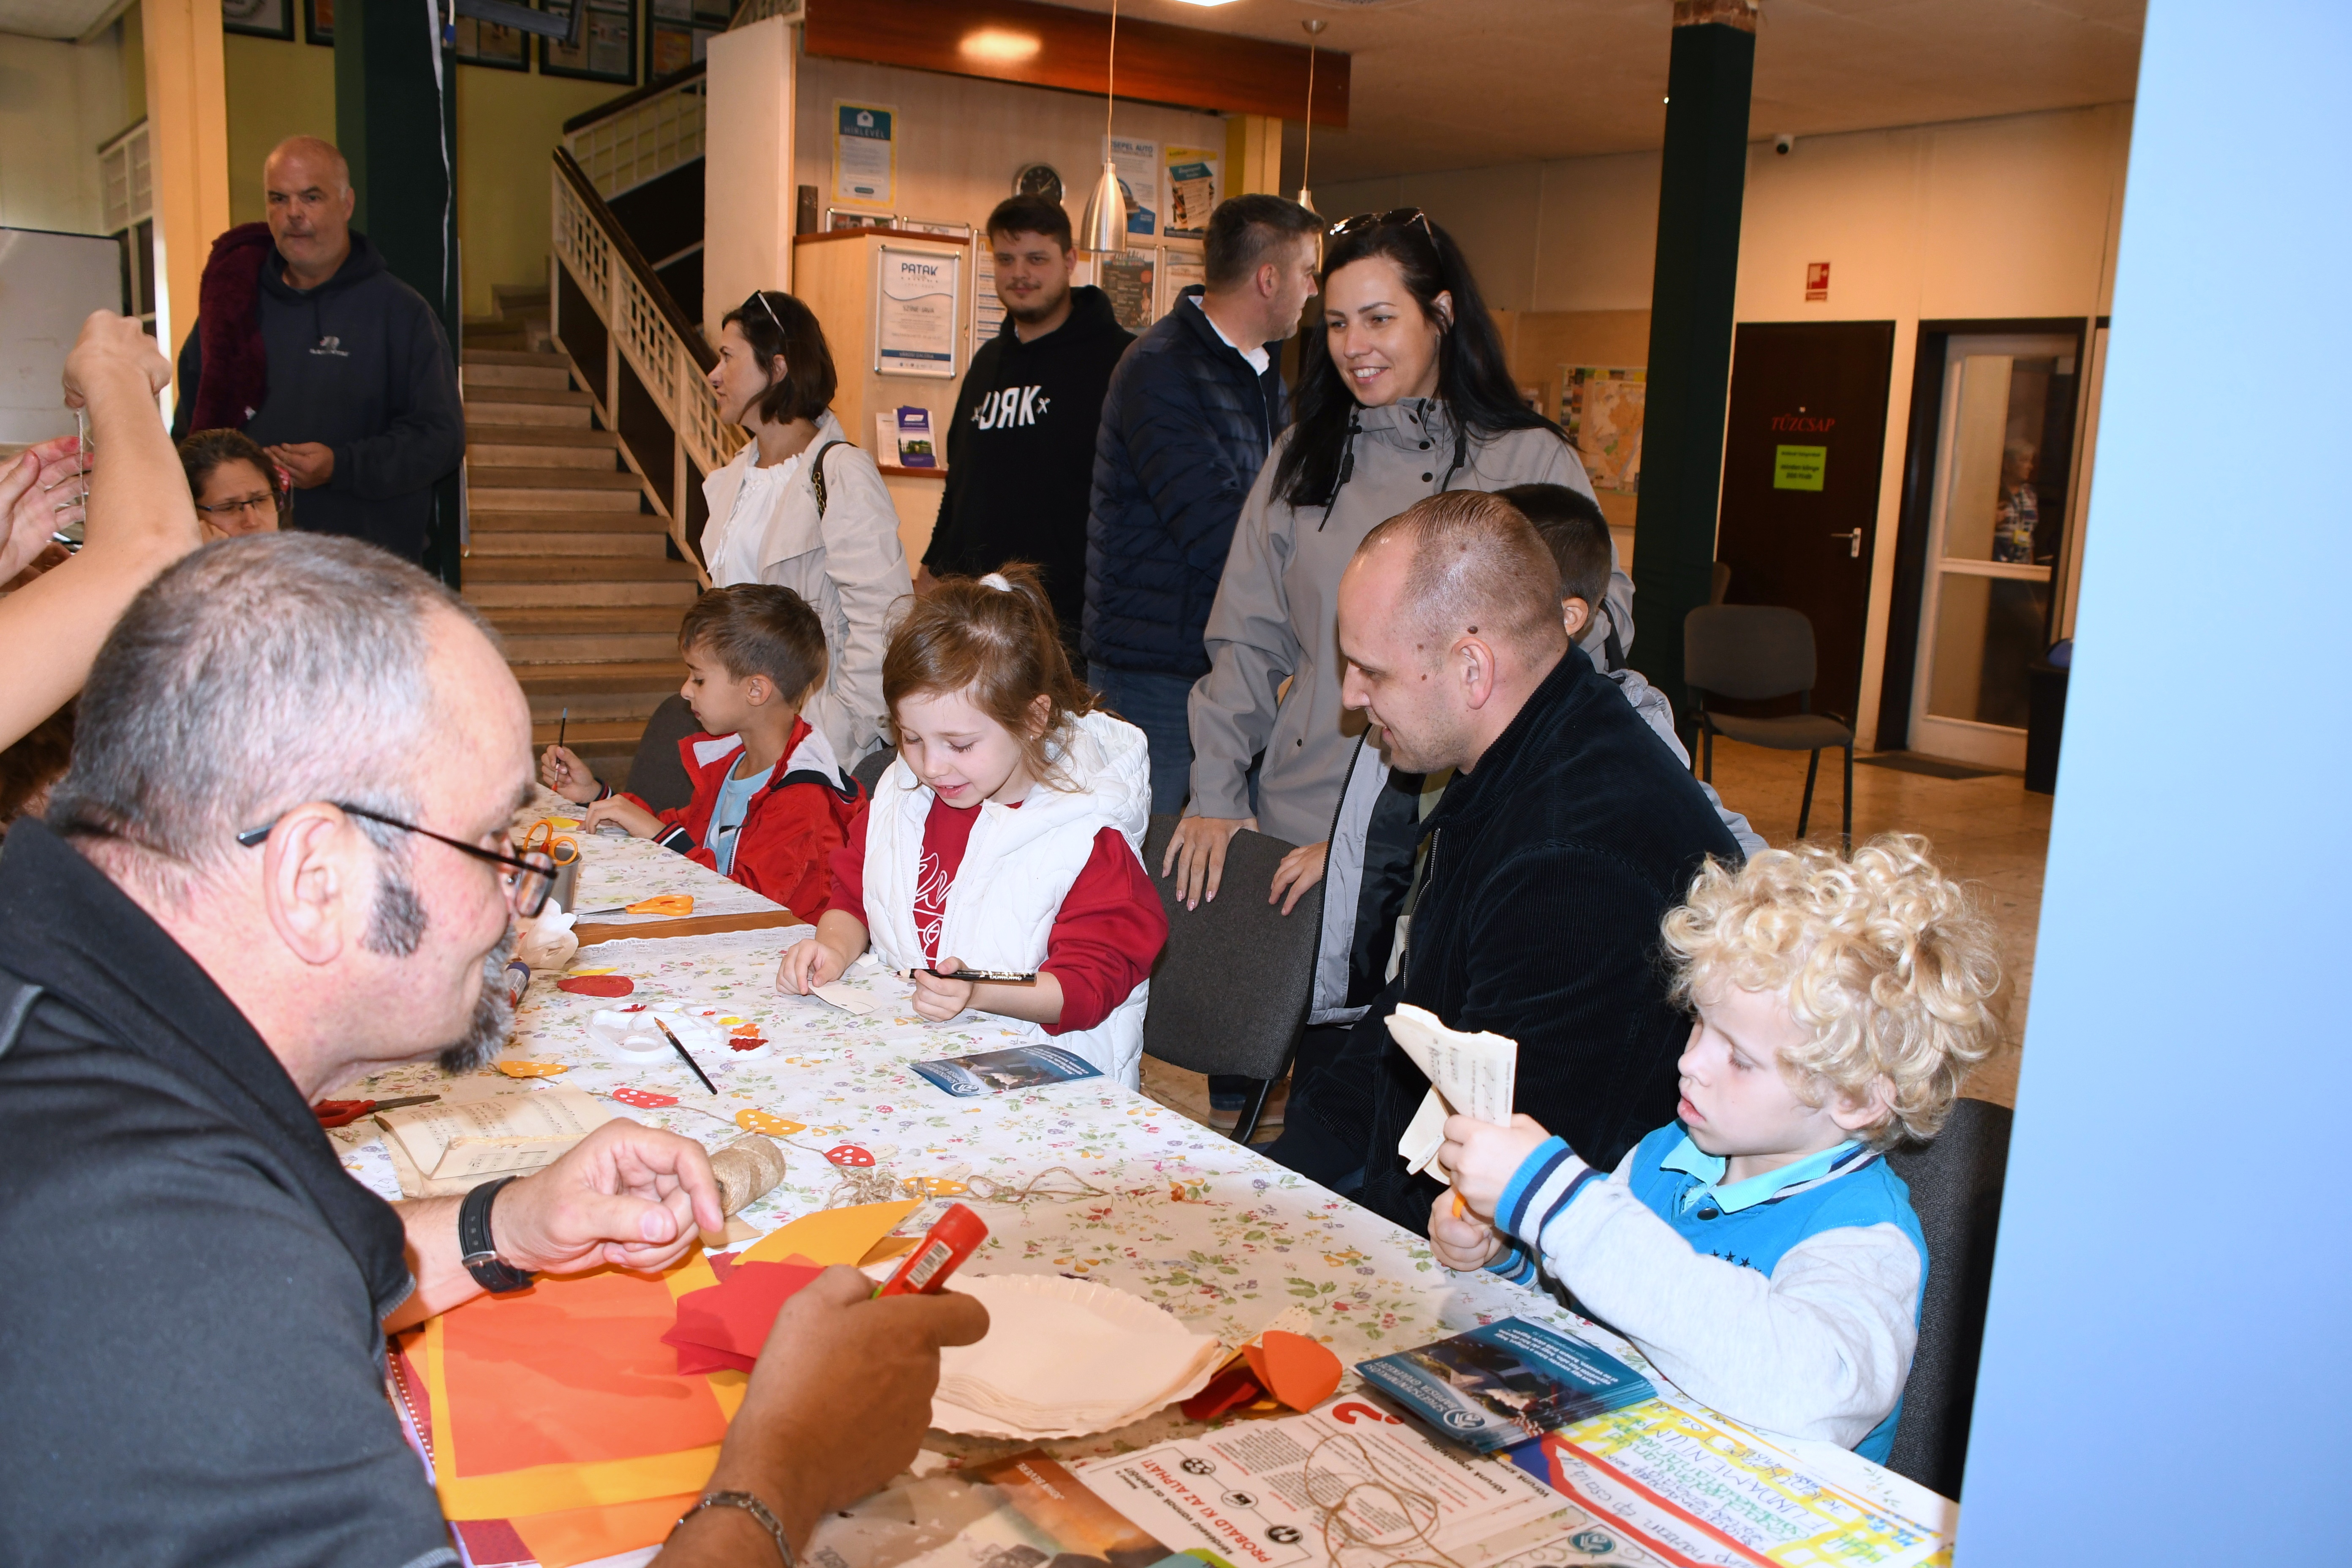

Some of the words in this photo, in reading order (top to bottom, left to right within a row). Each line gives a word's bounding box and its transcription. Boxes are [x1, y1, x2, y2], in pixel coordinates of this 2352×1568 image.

[901, 262, 938, 276] PATAK
[1135, 1459, 1191, 1495] ALPHÁT!
[1469, 1471, 1508, 1494] Várunk
[1514, 1474, 1551, 1497] Várunk
[1158, 1497, 1195, 1522] vannak
[1182, 1493, 1206, 1507] AZ
[1198, 1506, 1220, 1518] KI
[1187, 1522, 1236, 1555] kérdéseid
[1208, 1518, 1275, 1564] PRÓBÁLD
